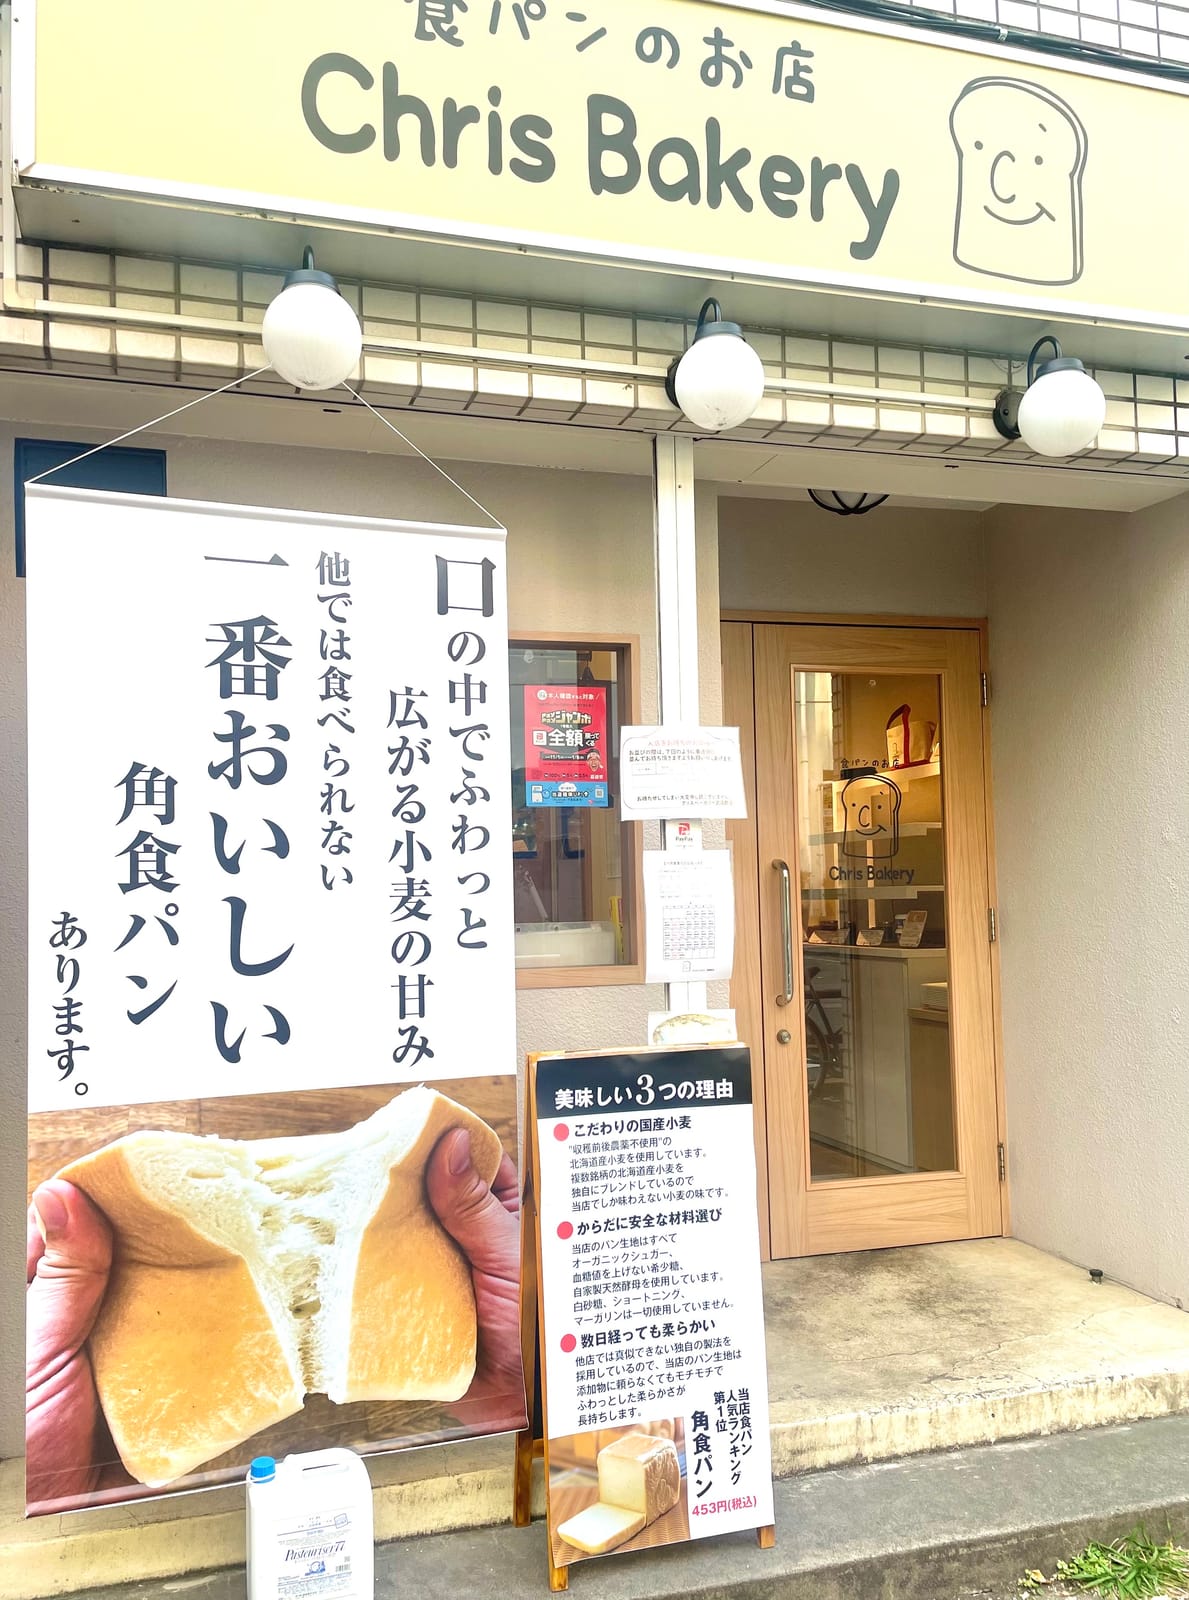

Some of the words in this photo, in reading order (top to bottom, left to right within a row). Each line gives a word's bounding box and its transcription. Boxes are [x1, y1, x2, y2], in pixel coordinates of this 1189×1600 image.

[301, 52, 556, 183] Chris
[587, 93, 900, 260] Bakery
[314, 551, 356, 891] 他では食べられない
[435, 554, 497, 949] 口の中でふわっと
[548, 729, 584, 747] 全額
[841, 757, 900, 769] 食パンのお店
[203, 553, 295, 1063] 一番おいしい
[386, 685, 435, 1067] 広がる小麦の甘み
[829, 865, 863, 880] Chris
[867, 865, 915, 884] Bakery
[113, 761, 183, 1026] 角食パン
[47, 911, 91, 1096] あります。
[555, 1073, 733, 1110] 美味しい3つの理由
[574, 1115, 692, 1137] こだわりの国産小麦
[570, 1148, 707, 1169] 北海道産小麦を使用しています。
[571, 1163, 684, 1184] 複数銘柄の北海道産小麦を
[571, 1176, 694, 1198] 独自にブレンドしているので
[571, 1188, 728, 1212] 当店でしか味わえない小麦の味です。
[577, 1208, 722, 1236] からだに安全な材料選び
[572, 1233, 678, 1254] 当店のパン生地はすべて
[572, 1249, 673, 1269] オーガニックシュガー、
[573, 1261, 684, 1283] 血糖値を上げない希少糖、
[573, 1271, 723, 1298] 自家製天然酵母を使用しています。
[573, 1289, 686, 1313] 白砂糖、ショートニング、
[574, 1298, 734, 1326] マーガリンは一切使用していません。
[580, 1320, 716, 1349] 数日経っても柔らかい
[575, 1336, 731, 1367] 他店では真似できない独自の製法を
[576, 1349, 742, 1382] 採用しているので、当店のパン生地は
[576, 1366, 723, 1396] 添加物に頼らなくてもモチモチで
[577, 1386, 686, 1411] ふわっとした柔らかさが
[714, 1391, 728, 1432] 第1位
[578, 1406, 643, 1426] 長持ちします。
[738, 1387, 752, 1456] 当店食パン
[726, 1389, 742, 1485] 人気ランキング
[691, 1410, 713, 1498] 角食パン
[692, 1495, 757, 1516] 453円(税込)
